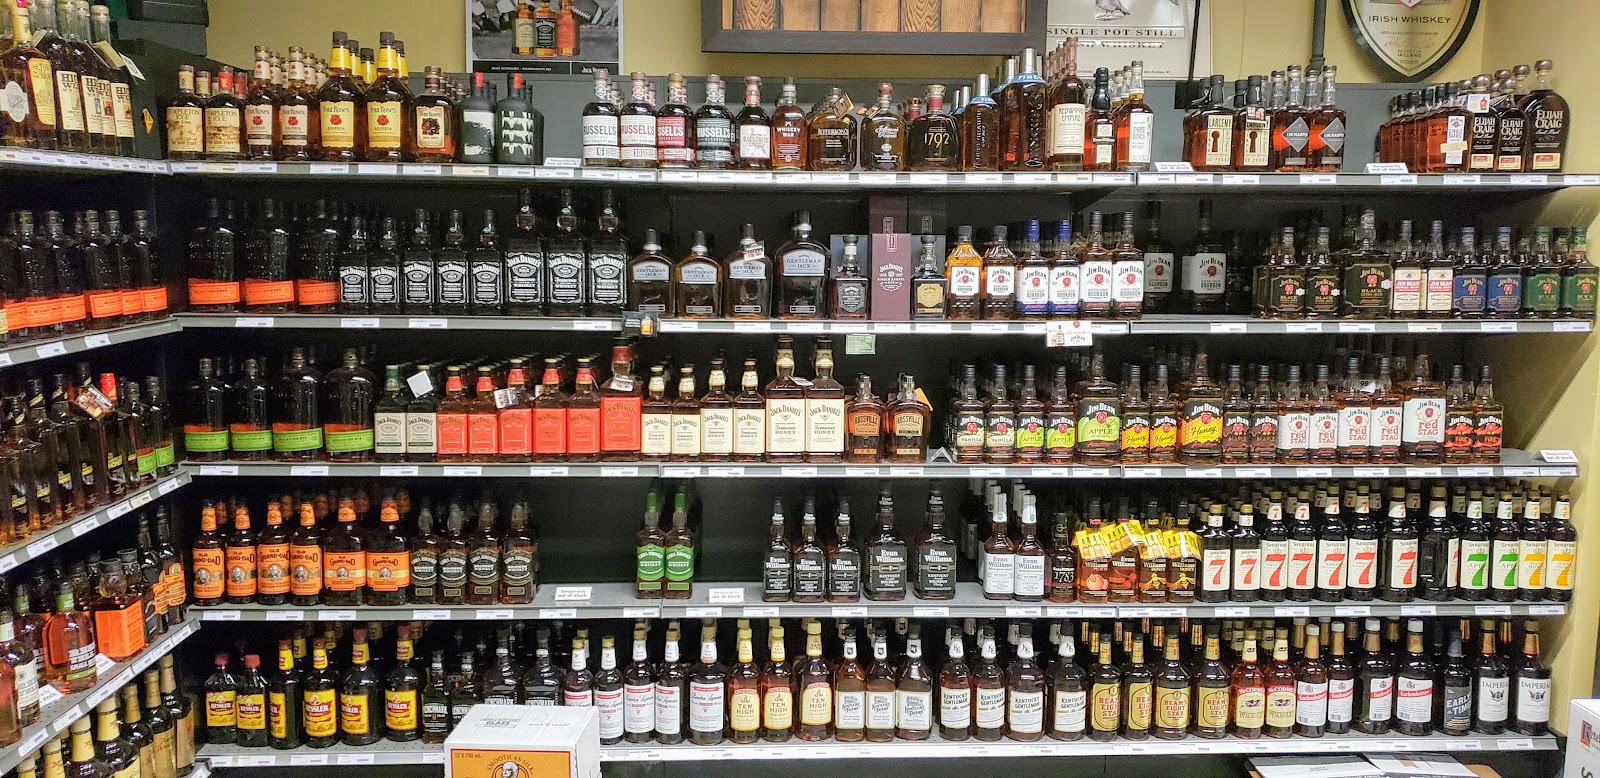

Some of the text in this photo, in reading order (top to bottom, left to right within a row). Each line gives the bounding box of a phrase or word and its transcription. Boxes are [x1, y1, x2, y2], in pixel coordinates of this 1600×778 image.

[1536, 109, 1563, 119] ELIJAH
[1208, 118, 1231, 128] LARCENY
[1535, 119, 1563, 128] CRAIG
[583, 123, 617, 136] RUSSELL'S
[621, 124, 656, 135] RUSSELL'S
[697, 127, 730, 137] RUSSELL'S
[924, 132, 949, 148] 1792
[633, 149, 642, 157] 10
[507, 254, 541, 267] JACK DANIEL'S
[549, 255, 582, 268] JACK DANIEL'S
[591, 256, 624, 269] JACK DANIEL'S
[1200, 257, 1224, 268] JIM BEAM
[1025, 270, 1047, 280] JIM BEAM
[1056, 270, 1077, 280] JIM BEAM
[1086, 265, 1111, 276] JIM BEAM
[1118, 265, 1143, 276] JIM BEAM
[1370, 268, 1385, 277] BEAM
[770, 404, 802, 417] JACK DANIEL'S
[810, 404, 841, 417] JACK DANIEL'S
[1087, 403, 1115, 415] JIM BEAM
[1192, 403, 1219, 416] JIM BEAM
[1417, 400, 1441, 410] JIM BEAM
[854, 415, 878, 424] ROSSVILLE
[897, 415, 922, 424] ROSSVILLE
[960, 416, 983, 426] JIM BEAM
[1021, 416, 1043, 426] JIM BEAM
[1226, 416, 1248, 427] JIM BEAM
[1418, 420, 1438, 430] red
[1478, 416, 1501, 426] JIM BEAM
[1192, 426, 1216, 437] Honey
[1209, 559, 1226, 585] 7
[1266, 554, 1287, 586] 7
[1292, 554, 1314, 586] 7
[1325, 554, 1346, 586] 7
[1468, 554, 1488, 586] 7
[1524, 554, 1546, 586] 7
[1552, 554, 1574, 586] 7
[1055, 571, 1074, 583] 1783
[944, 696, 969, 705] GENTLEMAN
[1447, 693, 1471, 707] EARLY
[305, 705, 330, 713] KESSLER
[487, 754, 513, 771] SMOOTH
